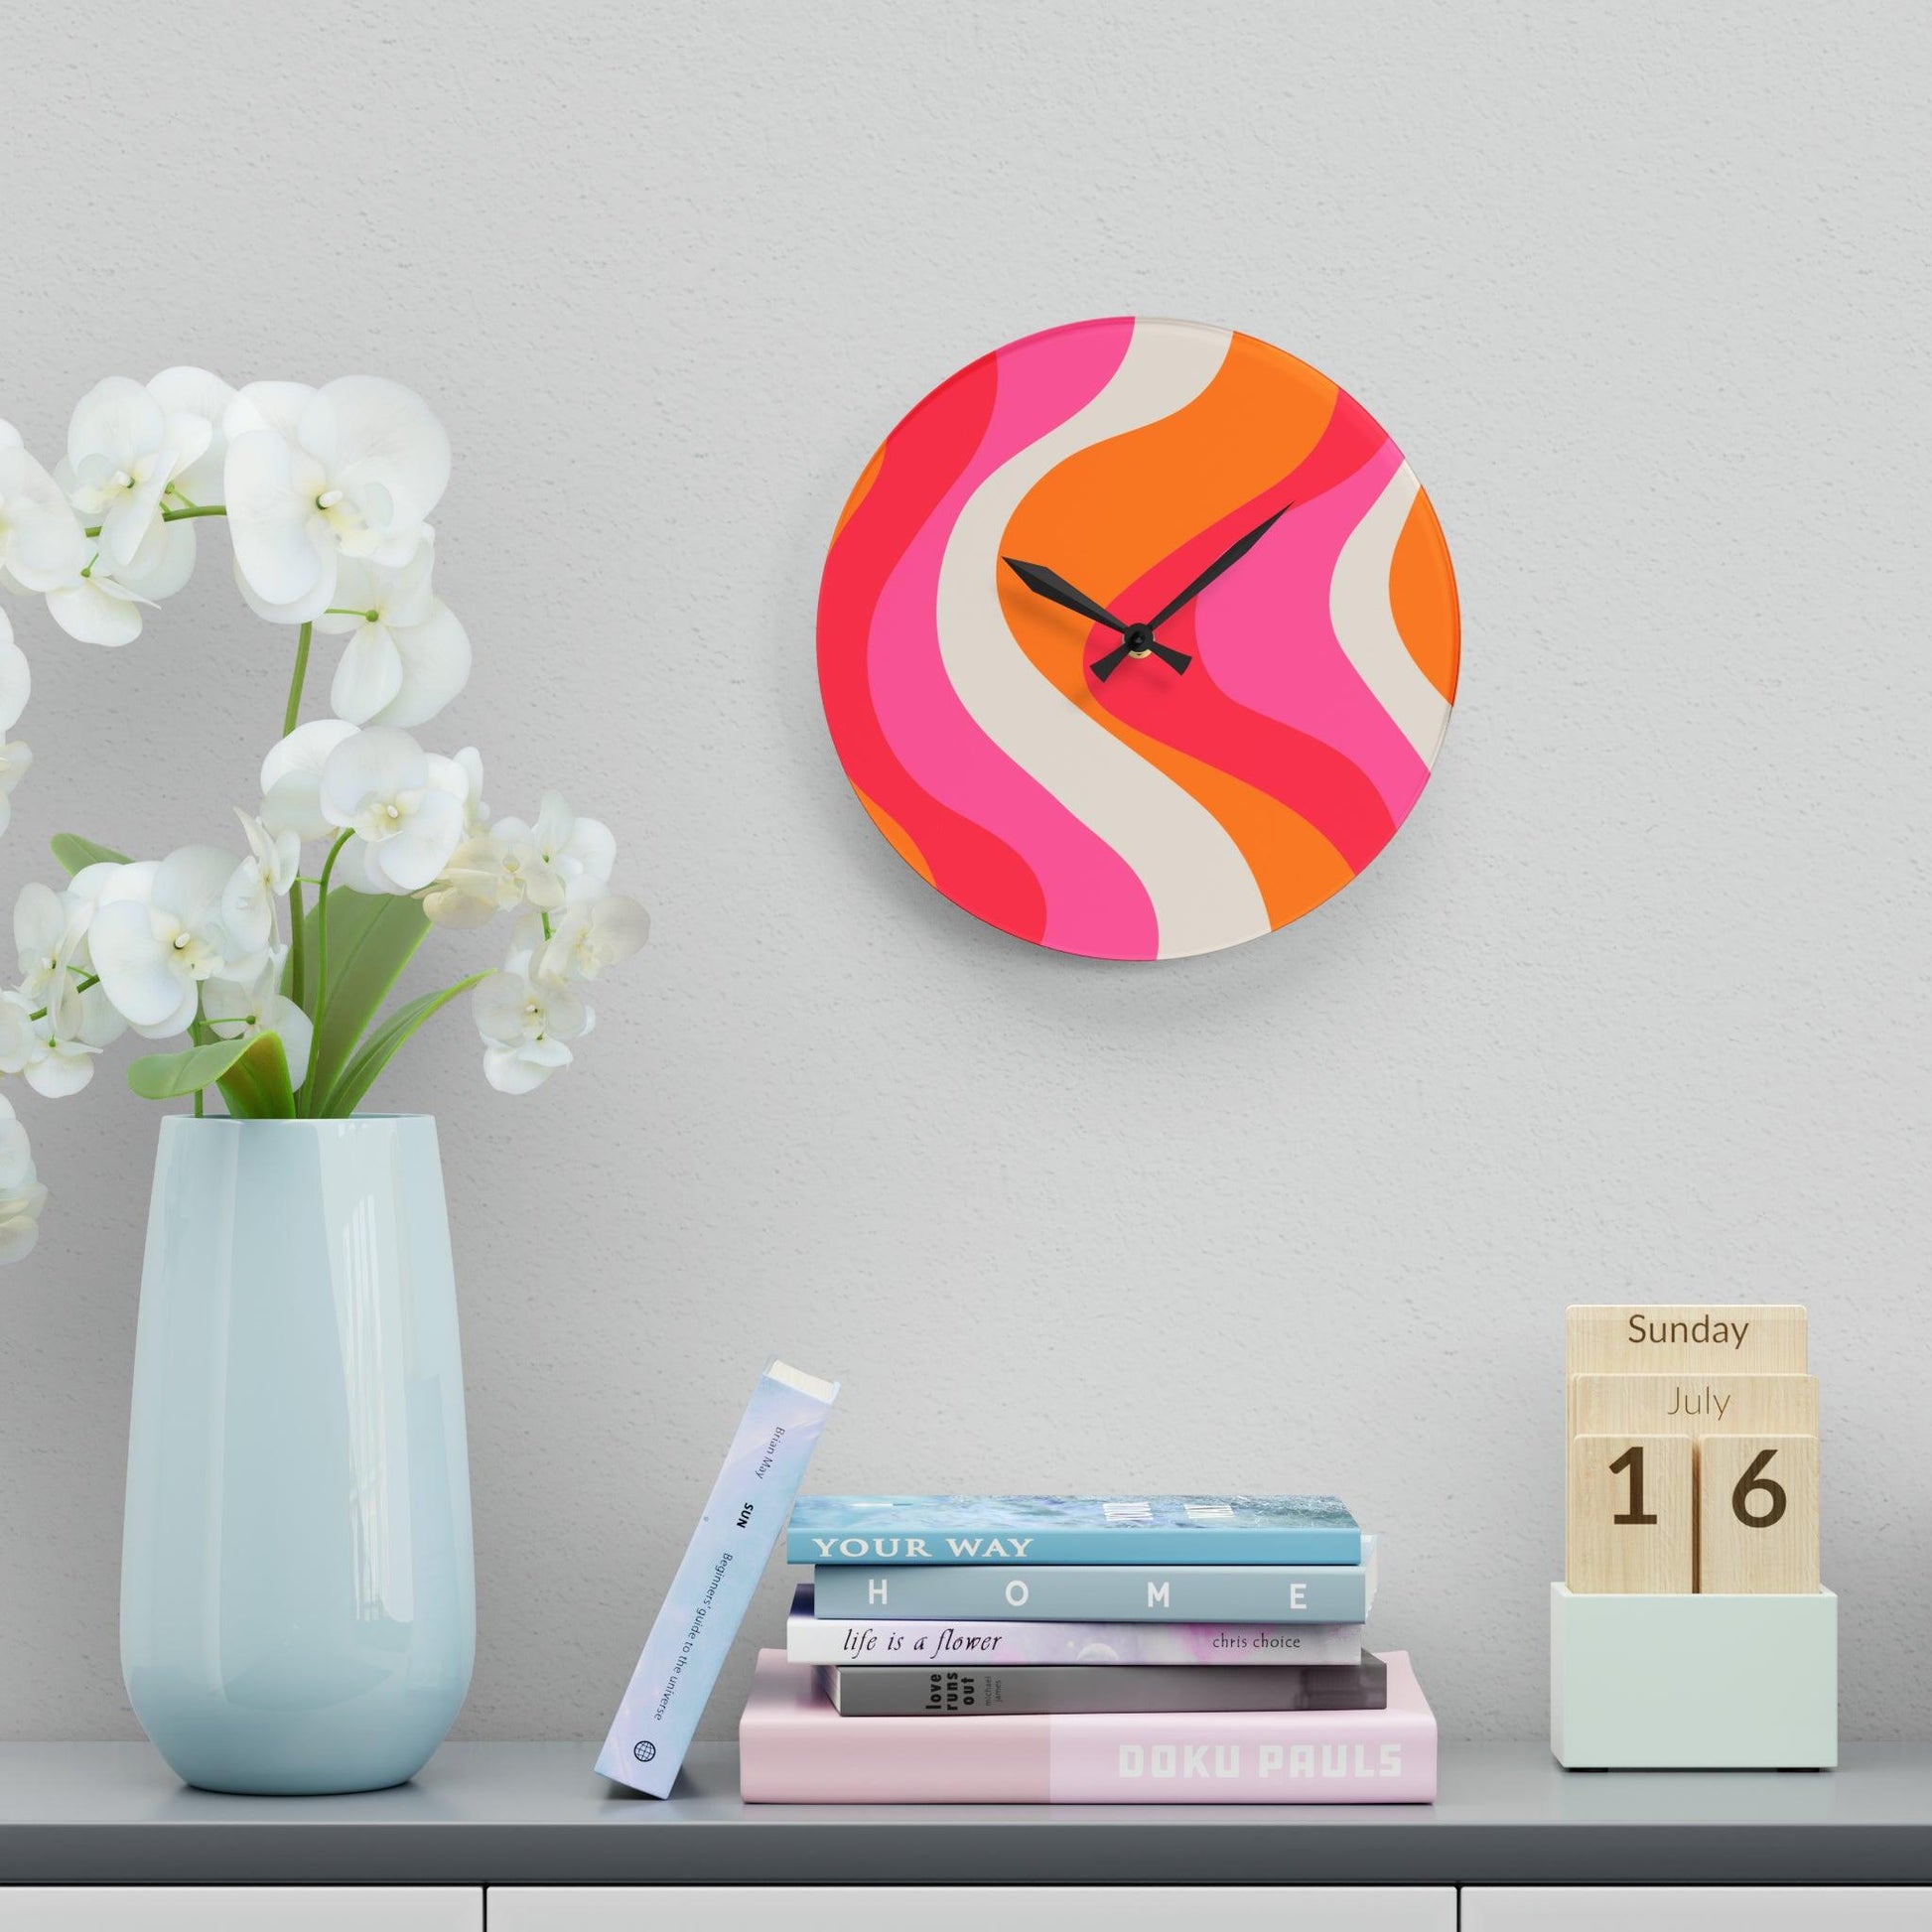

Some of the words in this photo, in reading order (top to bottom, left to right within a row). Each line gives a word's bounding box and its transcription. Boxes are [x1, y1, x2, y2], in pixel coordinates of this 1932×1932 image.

[1627, 1313, 1749, 1350] Sunday
[1666, 1386, 1732, 1421] July
[766, 1426, 785, 1454] Brian
[755, 1455, 773, 1479] May
[736, 1502, 754, 1529] SUN
[811, 1538, 933, 1558] YOUR
[945, 1538, 1035, 1558] WAY
[868, 1578, 1308, 1609] HOME
[687, 1607, 707, 1639] guide
[682, 1641, 694, 1653] to
[843, 1627, 878, 1660] life
[887, 1631, 904, 1651] is
[913, 1636, 928, 1651] a
[929, 1627, 1003, 1660] flower
[1212, 1632, 1248, 1648] chris
[1253, 1632, 1301, 1648] choice
[673, 1655, 688, 1674] the
[653, 1675, 678, 1721] universe
[925, 1673, 942, 1710] love
[946, 1672, 958, 1711] runs
[960, 1677, 975, 1706] out
[1119, 1743, 1241, 1778] DOKU
[1258, 1743, 1403, 1778] PAULS
